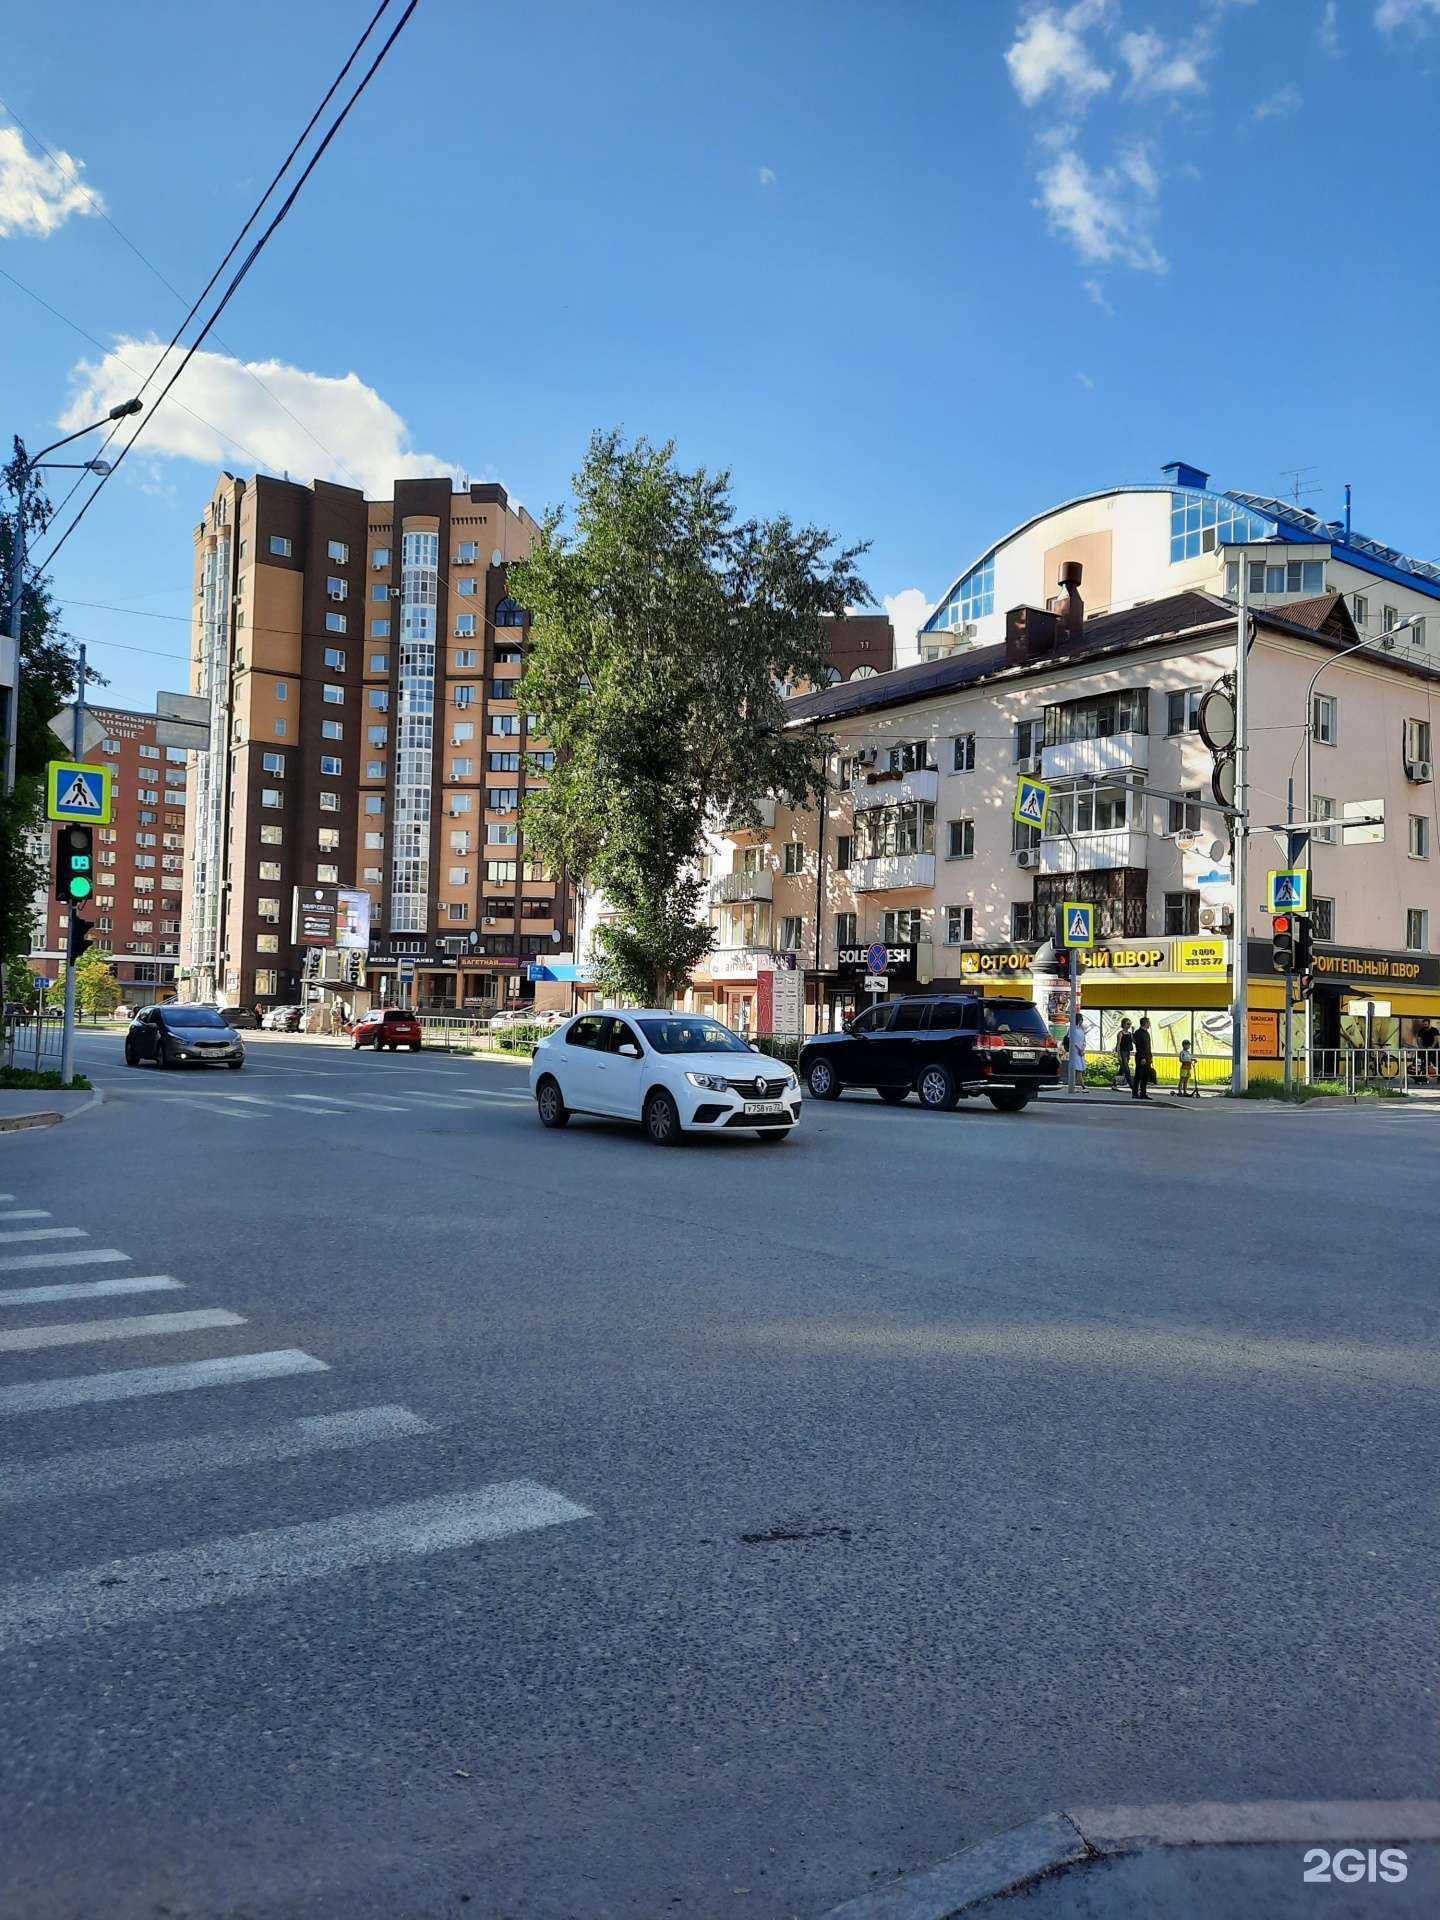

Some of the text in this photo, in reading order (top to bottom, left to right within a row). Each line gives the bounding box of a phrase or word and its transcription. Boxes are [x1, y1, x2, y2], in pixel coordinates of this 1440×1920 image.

[1113, 950, 1163, 968] ДВОР
[1311, 955, 1420, 978] РОИТЕЛЬНЫЙ ДВОР
